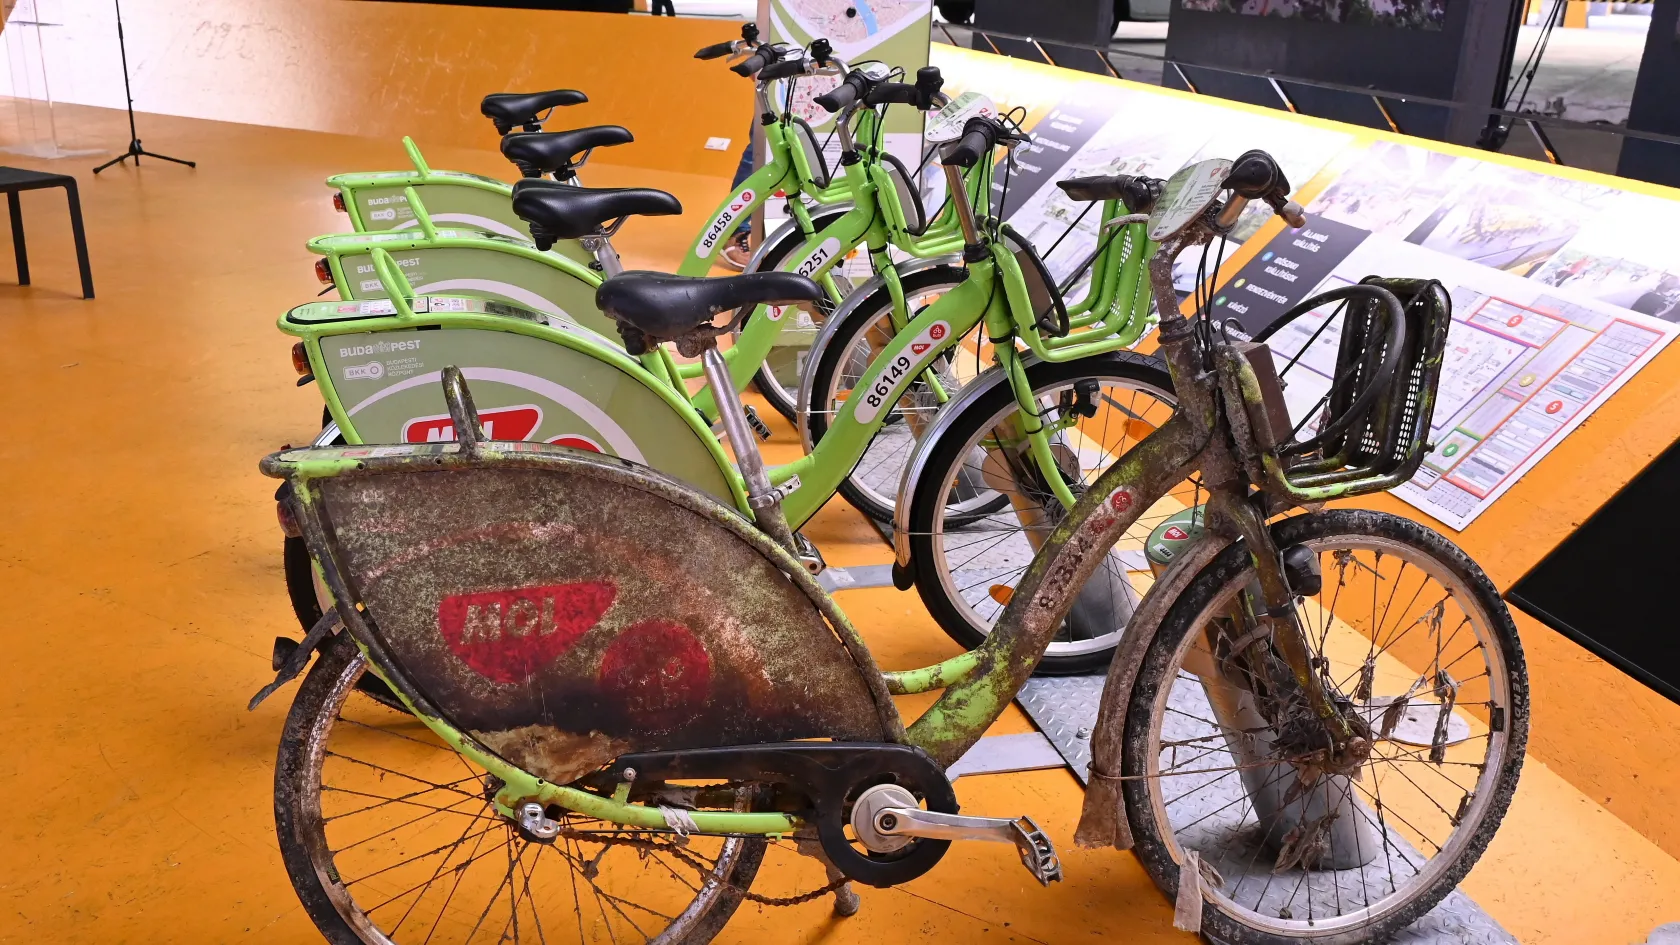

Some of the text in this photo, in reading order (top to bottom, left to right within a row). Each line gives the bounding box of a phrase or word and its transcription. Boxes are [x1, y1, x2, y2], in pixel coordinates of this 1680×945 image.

[703, 211, 733, 248] 86458
[1301, 228, 1329, 243] ÁLLANDÓ
[1292, 238, 1320, 253] KIÁLLÍTÁS
[1245, 283, 1289, 305] RENDEZVÉNYTÉR
[1226, 301, 1249, 315] KÁVÉZÓ
[386, 357, 416, 366] BUDAPESTI
[867, 356, 911, 408] 86149
[460, 597, 558, 645] MOL
